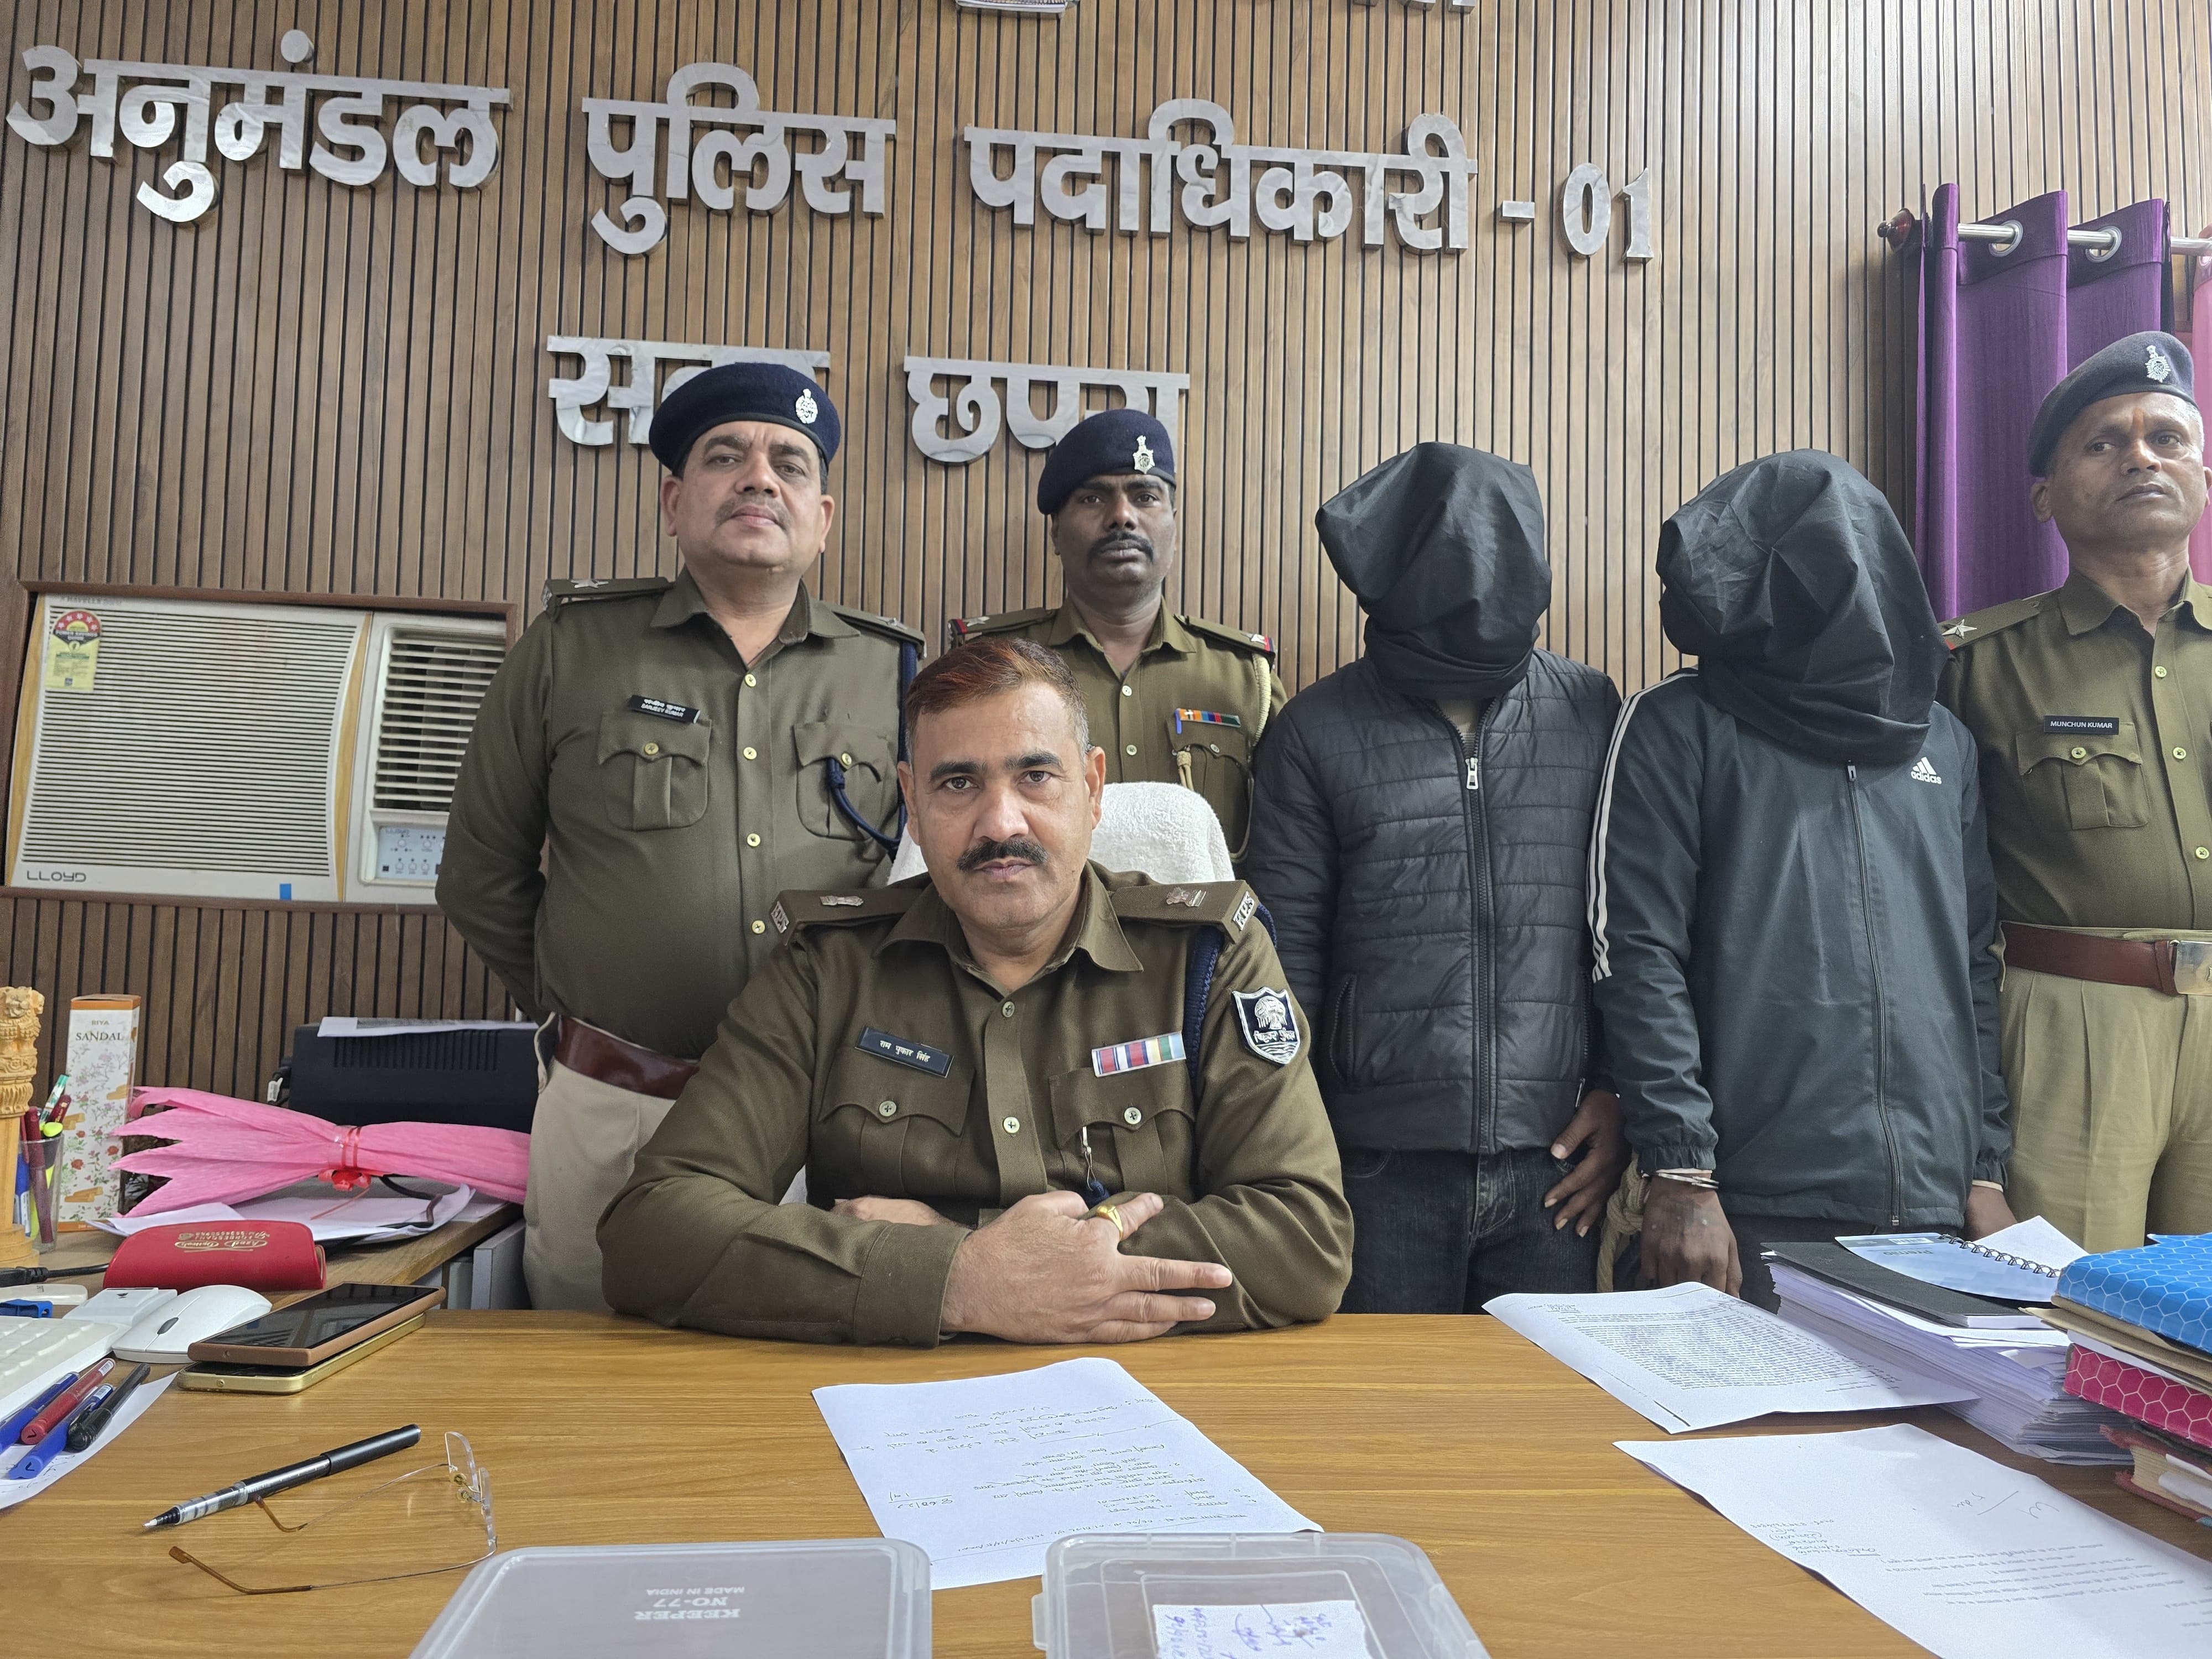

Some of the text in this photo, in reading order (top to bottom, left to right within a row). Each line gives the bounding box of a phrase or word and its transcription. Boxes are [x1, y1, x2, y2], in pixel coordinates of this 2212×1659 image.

[6, 29, 514, 223] अनुमंडल
[582, 62, 896, 255] पुलिस
[963, 98, 1478, 255] पदाधिकारी
[1561, 161, 1654, 263] 01
[1911, 770, 1942, 785] adidas
[27, 870, 86, 883] LLOYD
[75, 1031, 123, 1042] SANDAL
[1253, 1030, 1279, 1043] बिहार
[880, 1040, 931, 1062] राम पुकार सिंह
[646, 1588, 684, 1596] INDIA
[703, 1587, 745, 1595] MADE
[653, 1597, 728, 1608] NO-77
[634, 1608, 741, 1620] KEEPER
